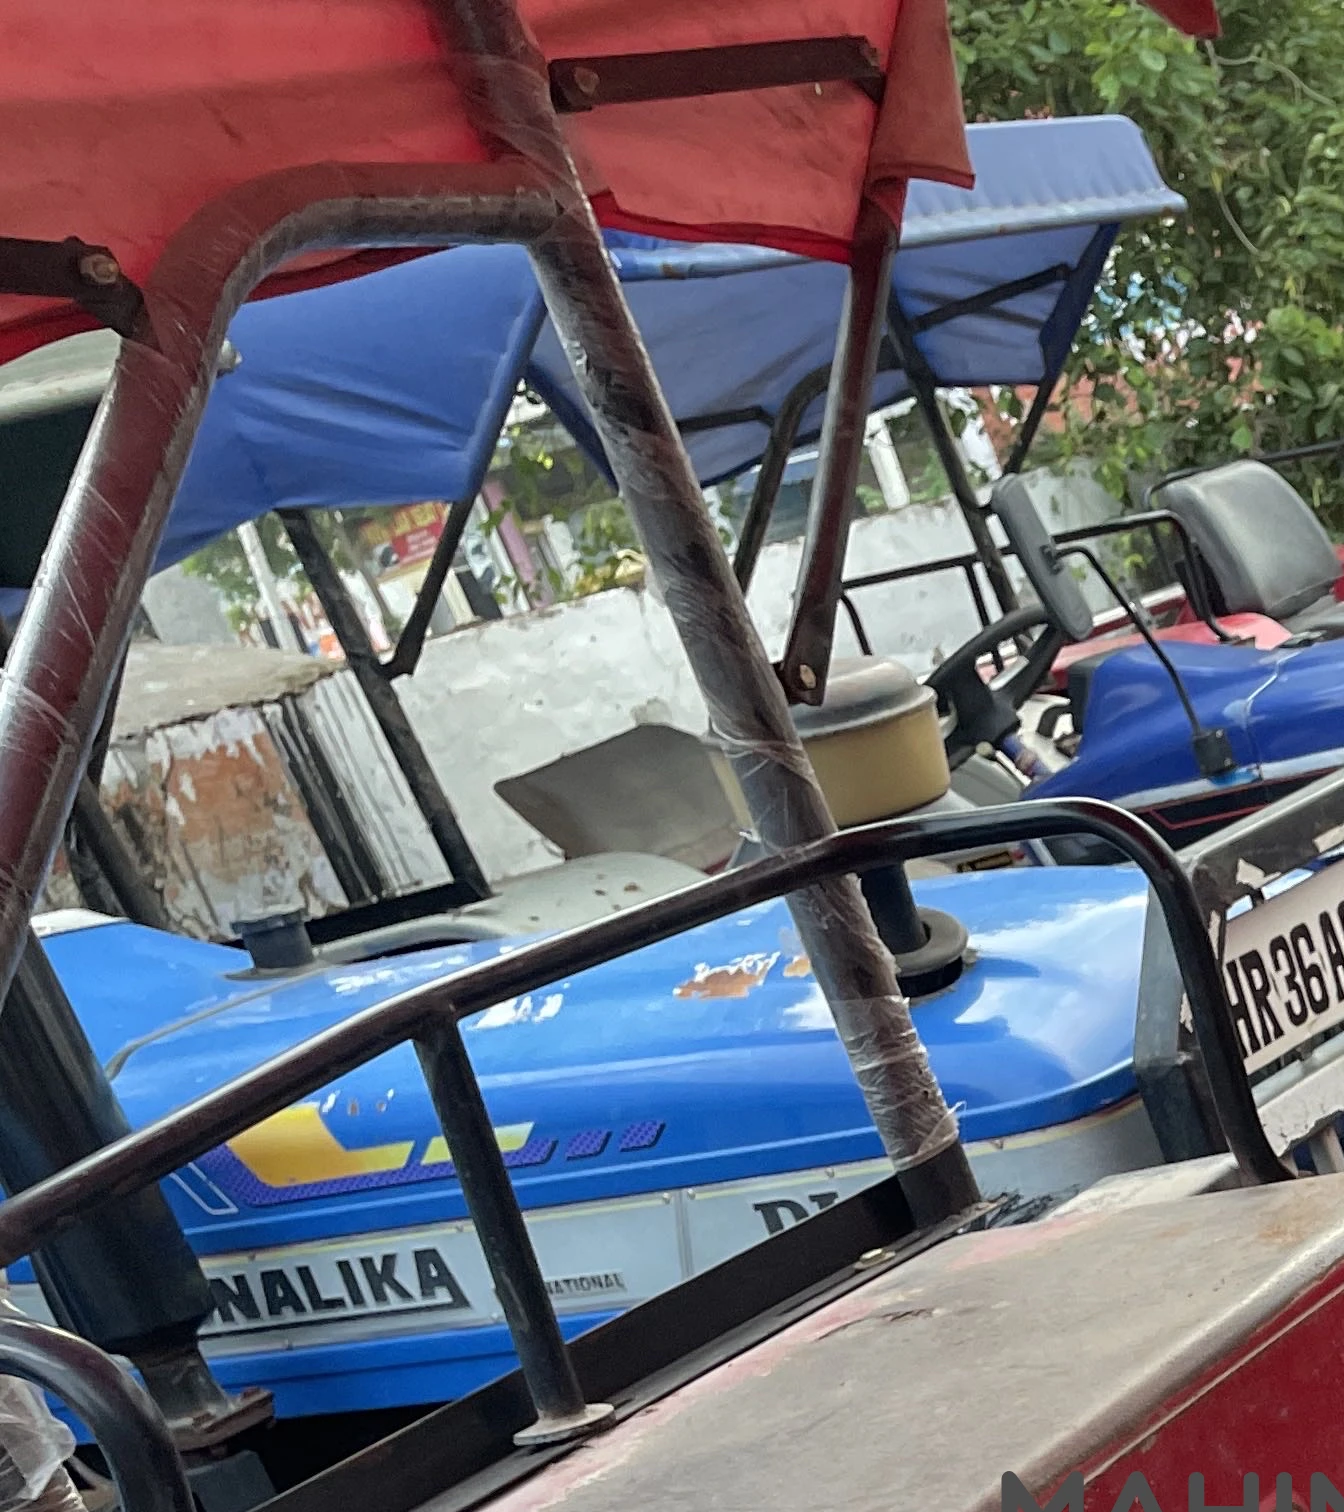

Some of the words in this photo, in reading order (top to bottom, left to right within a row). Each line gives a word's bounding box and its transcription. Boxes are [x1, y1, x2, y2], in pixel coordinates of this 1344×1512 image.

[1225, 949, 1285, 1058] HR
[1269, 922, 1330, 1026] 36
[203, 1248, 471, 1323] NALIKA
[543, 1272, 628, 1295] NATIONAL
